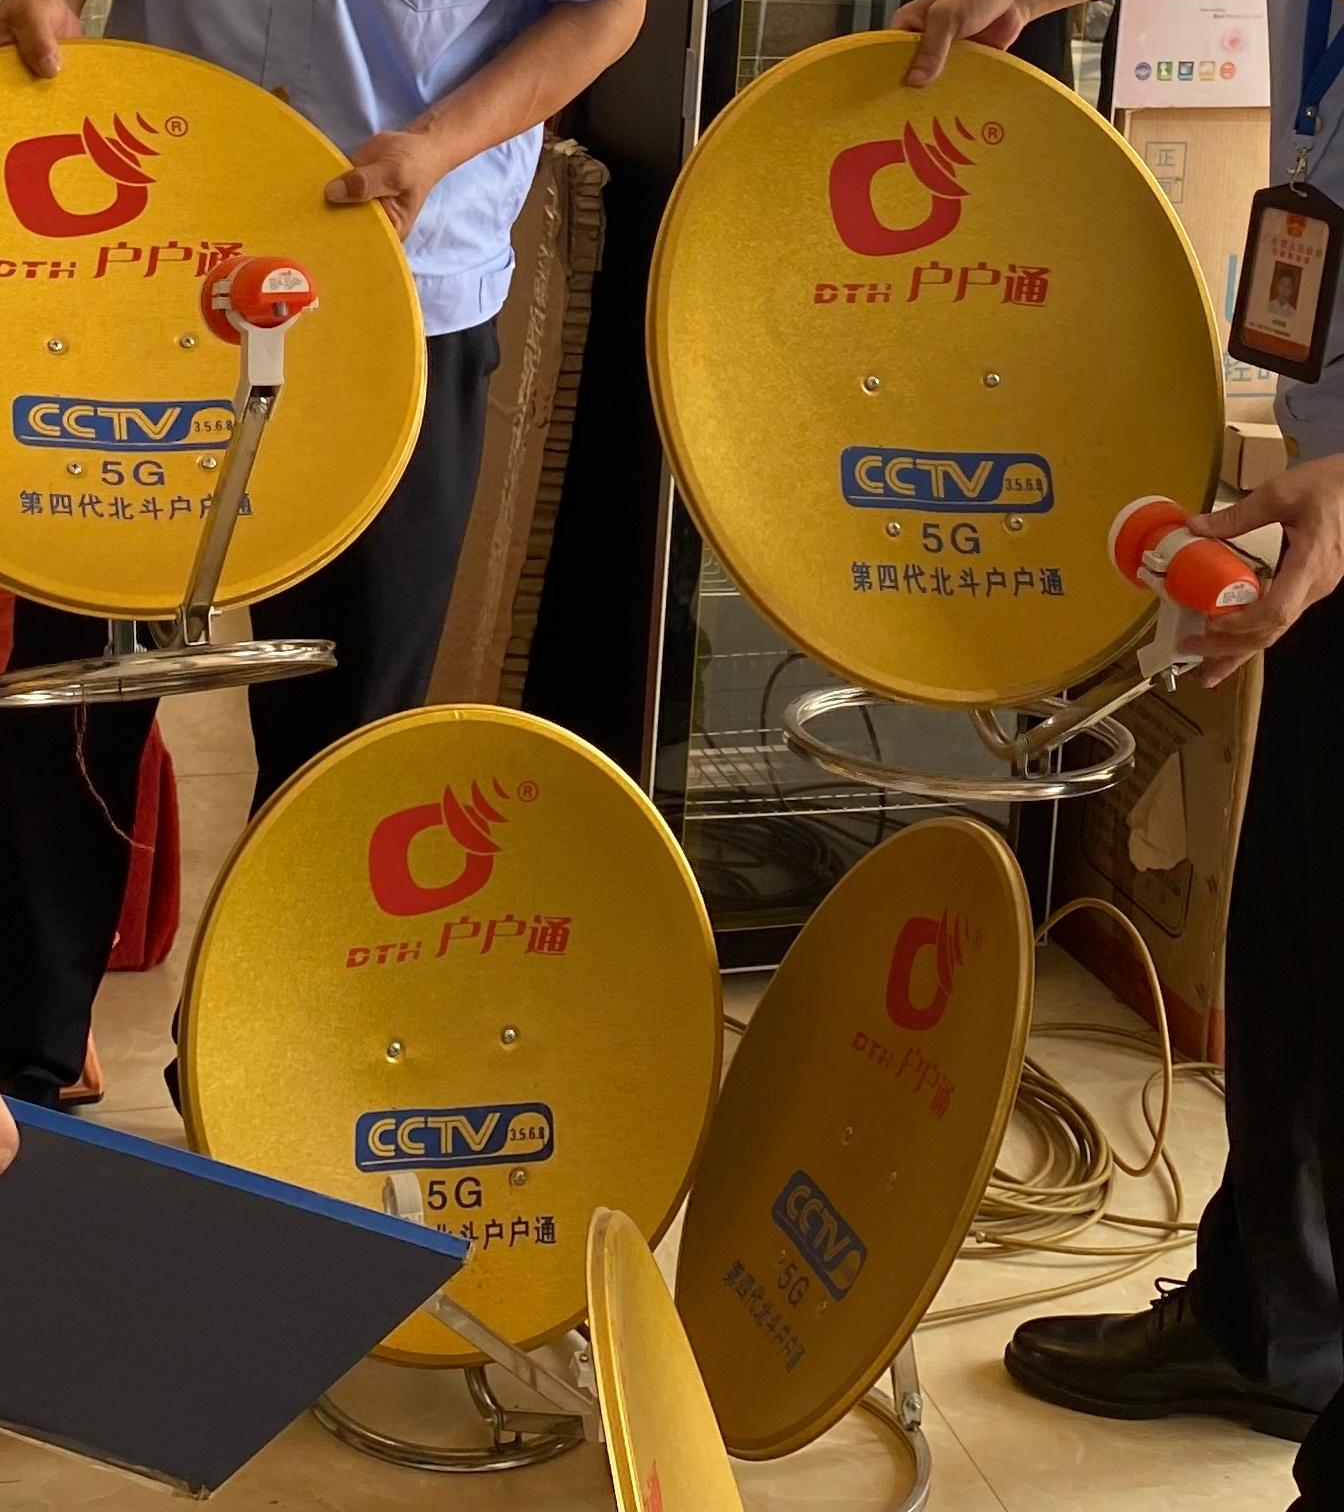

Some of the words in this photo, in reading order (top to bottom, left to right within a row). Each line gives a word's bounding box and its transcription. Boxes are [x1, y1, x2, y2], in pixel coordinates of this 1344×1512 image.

[814, 283, 892, 304] DTH
[907, 261, 1050, 308] 户户通
[28, 402, 182, 441] CCTV
[101, 460, 166, 486] 5G
[855, 455, 994, 498] CCTV
[922, 522, 981, 554] 5G
[852, 561, 1065, 596] 第四代北斗户户通
[346, 941, 422, 968] DTH
[435, 913, 572, 958] 户户通
[367, 1112, 501, 1157] CCTV
[427, 1176, 482, 1210] 5G
[786, 1185, 851, 1262] CCTV
[777, 1262, 810, 1309] 5G
